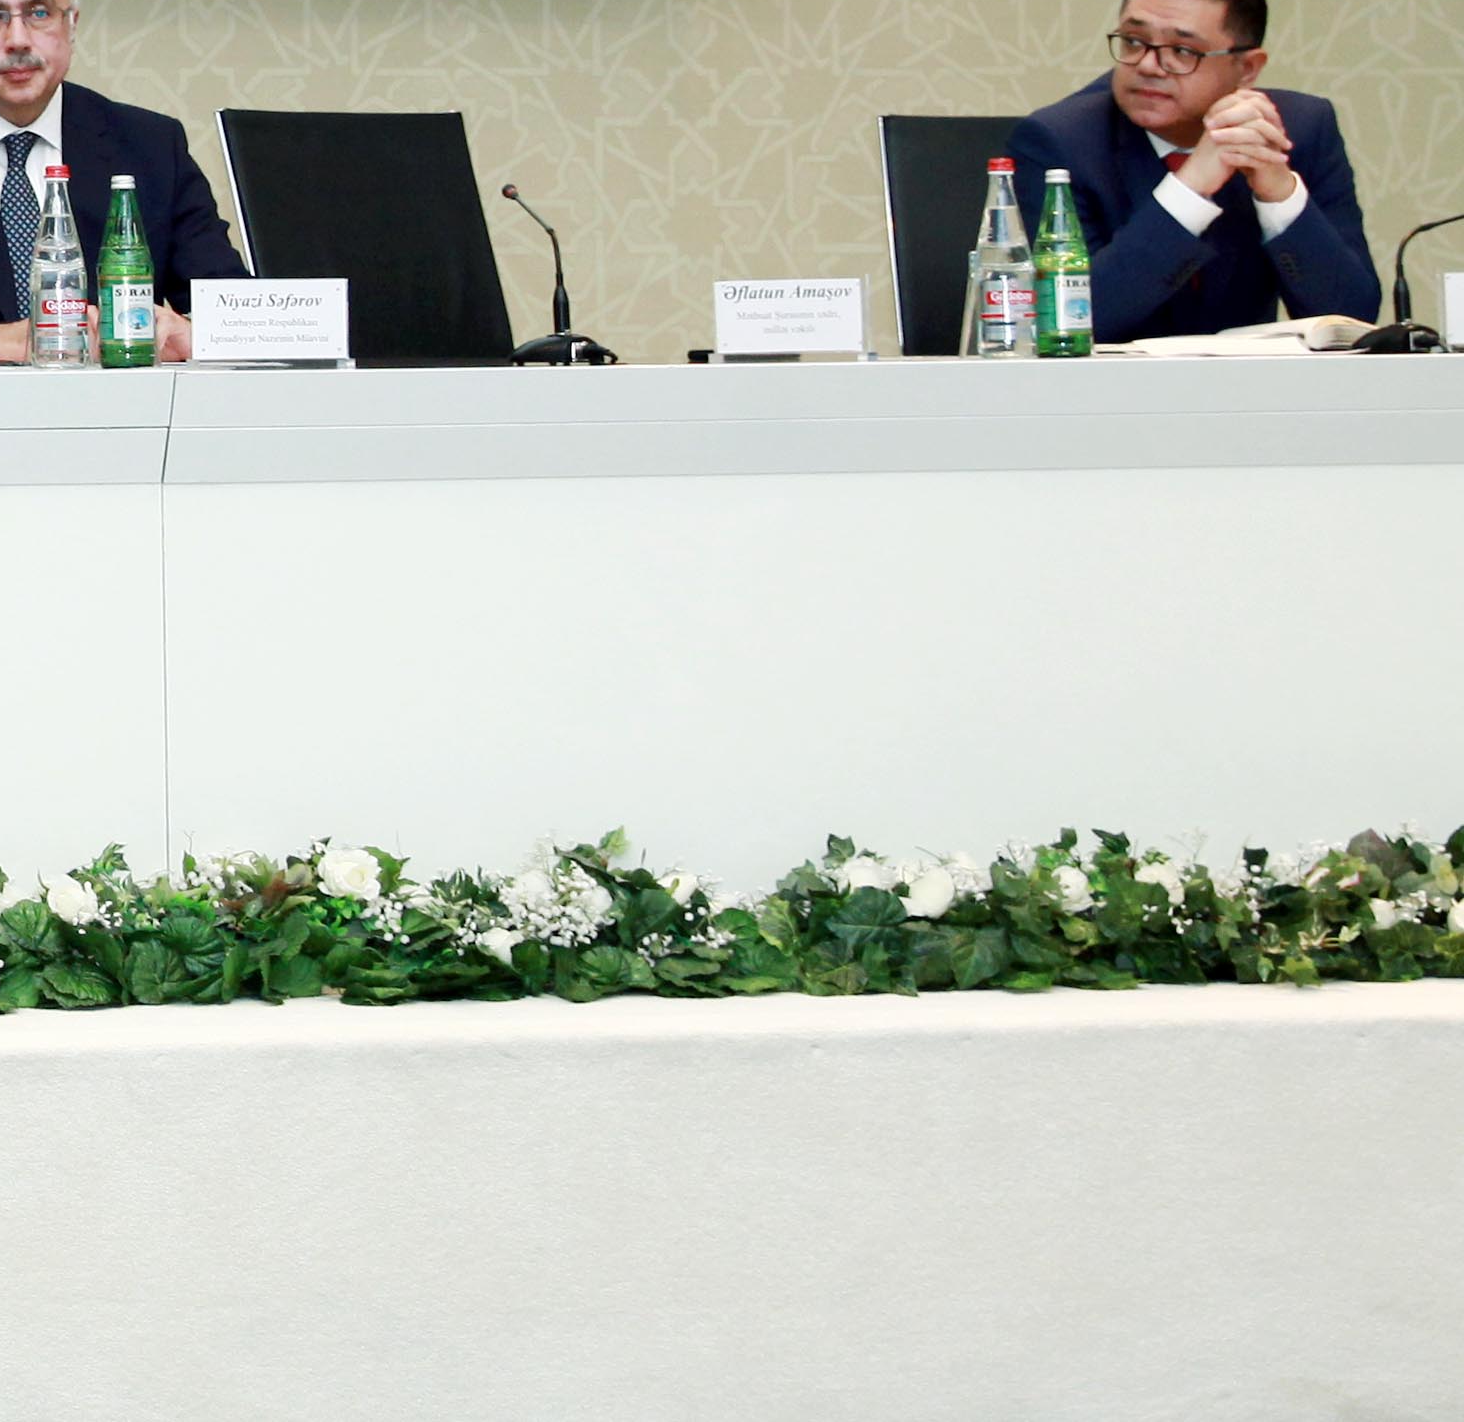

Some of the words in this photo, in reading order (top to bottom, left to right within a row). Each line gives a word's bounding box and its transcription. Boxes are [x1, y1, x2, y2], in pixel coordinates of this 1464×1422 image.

[215, 293, 263, 309] Niyazi
[266, 293, 323, 311] Səfərov
[724, 285, 785, 303] Əflatun
[789, 284, 852, 301] Amaşov
